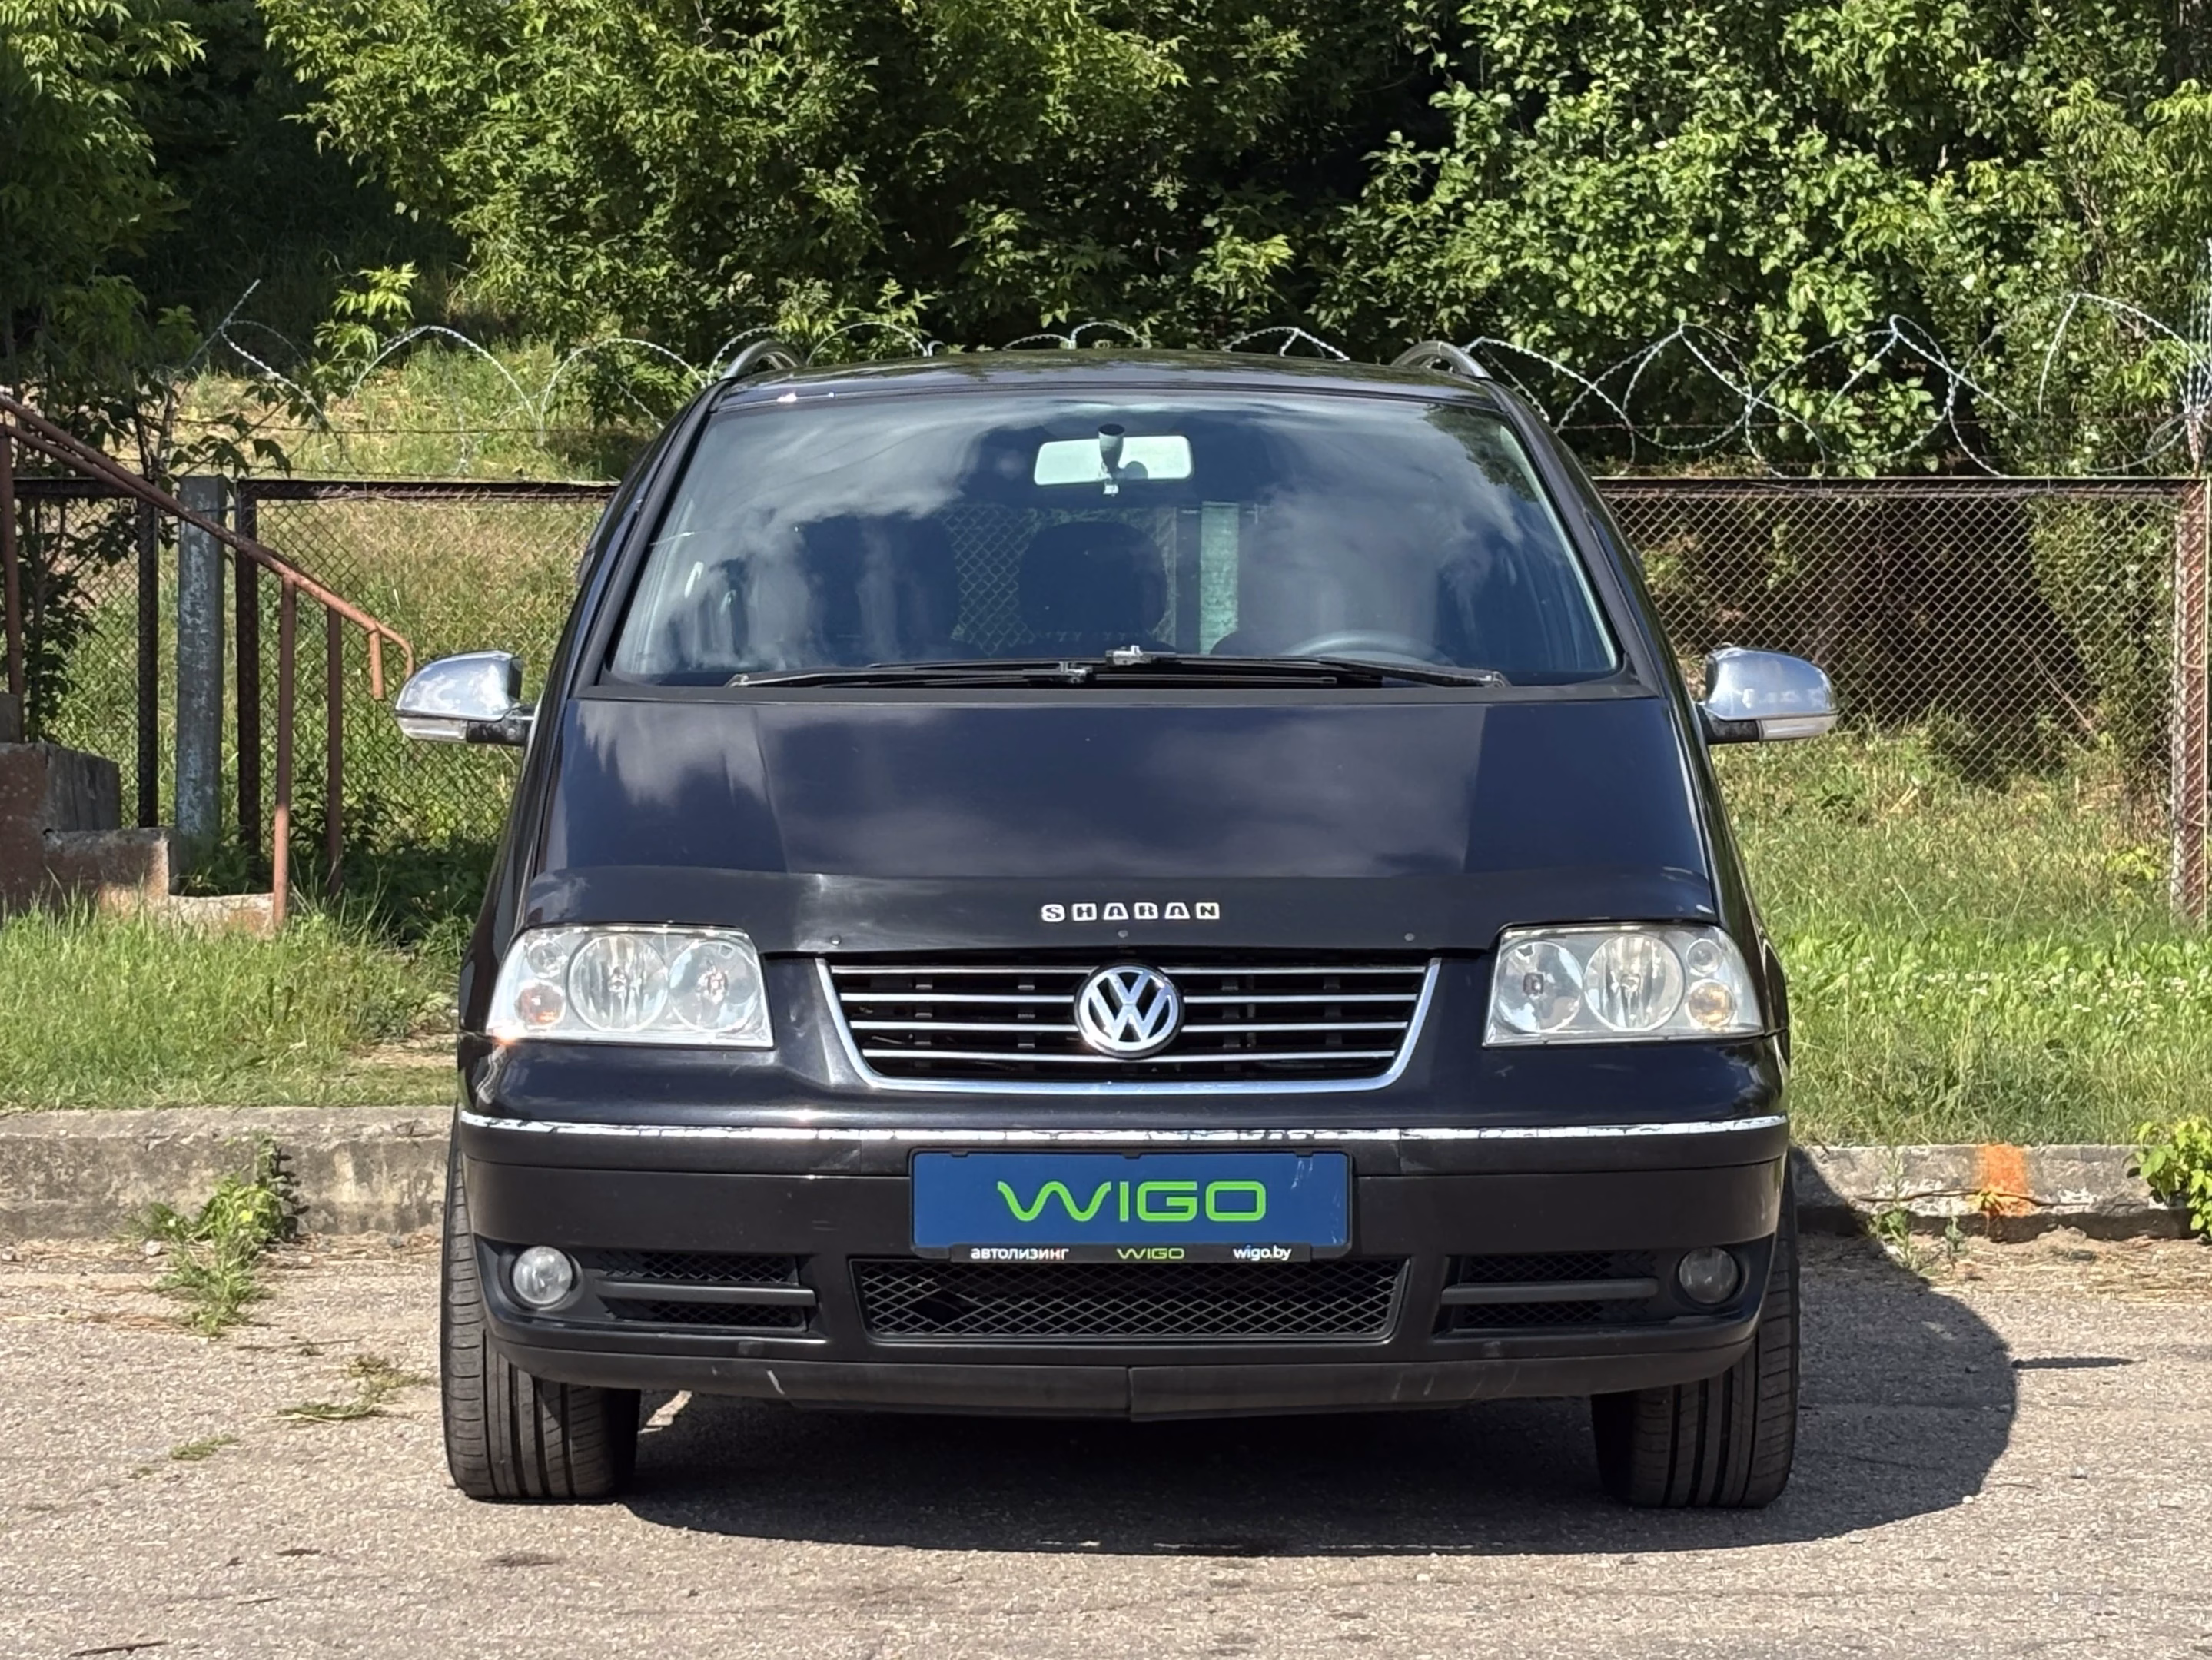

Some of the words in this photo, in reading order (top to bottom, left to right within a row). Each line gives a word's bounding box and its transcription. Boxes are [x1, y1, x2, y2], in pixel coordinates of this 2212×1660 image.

[1041, 901, 1221, 922] SHARAN
[1079, 965, 1179, 1051] VW
[997, 1180, 1267, 1222] WIGO
[971, 1247, 1069, 1260] автолизинг
[1117, 1247, 1185, 1260] WIGO
[1233, 1246, 1292, 1261] wigo.by
